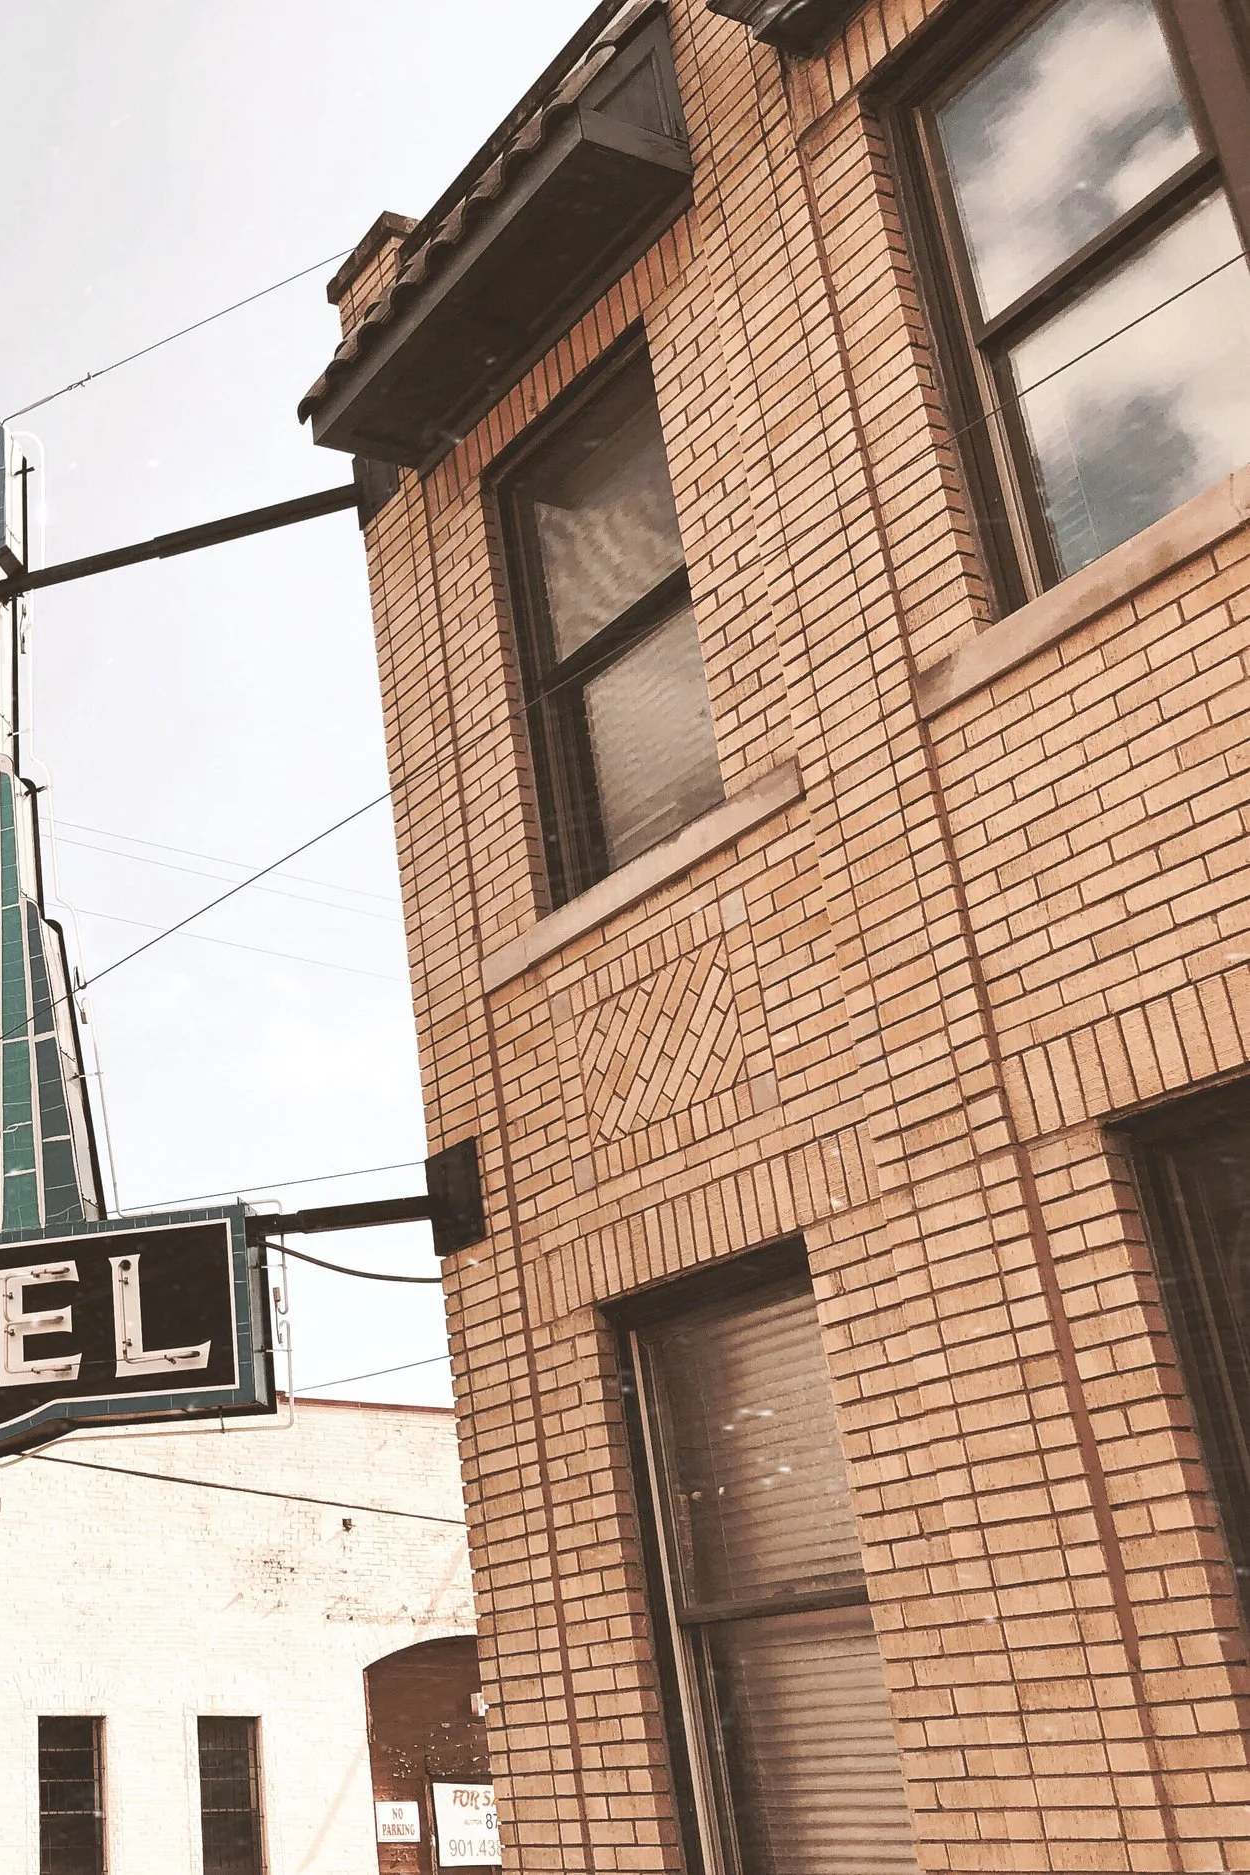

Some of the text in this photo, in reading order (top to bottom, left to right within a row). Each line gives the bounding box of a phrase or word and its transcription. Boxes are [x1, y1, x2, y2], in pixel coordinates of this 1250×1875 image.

[453, 1789, 480, 1810] FOR
[392, 1807, 404, 1820] NO
[382, 1823, 415, 1836] PARKING
